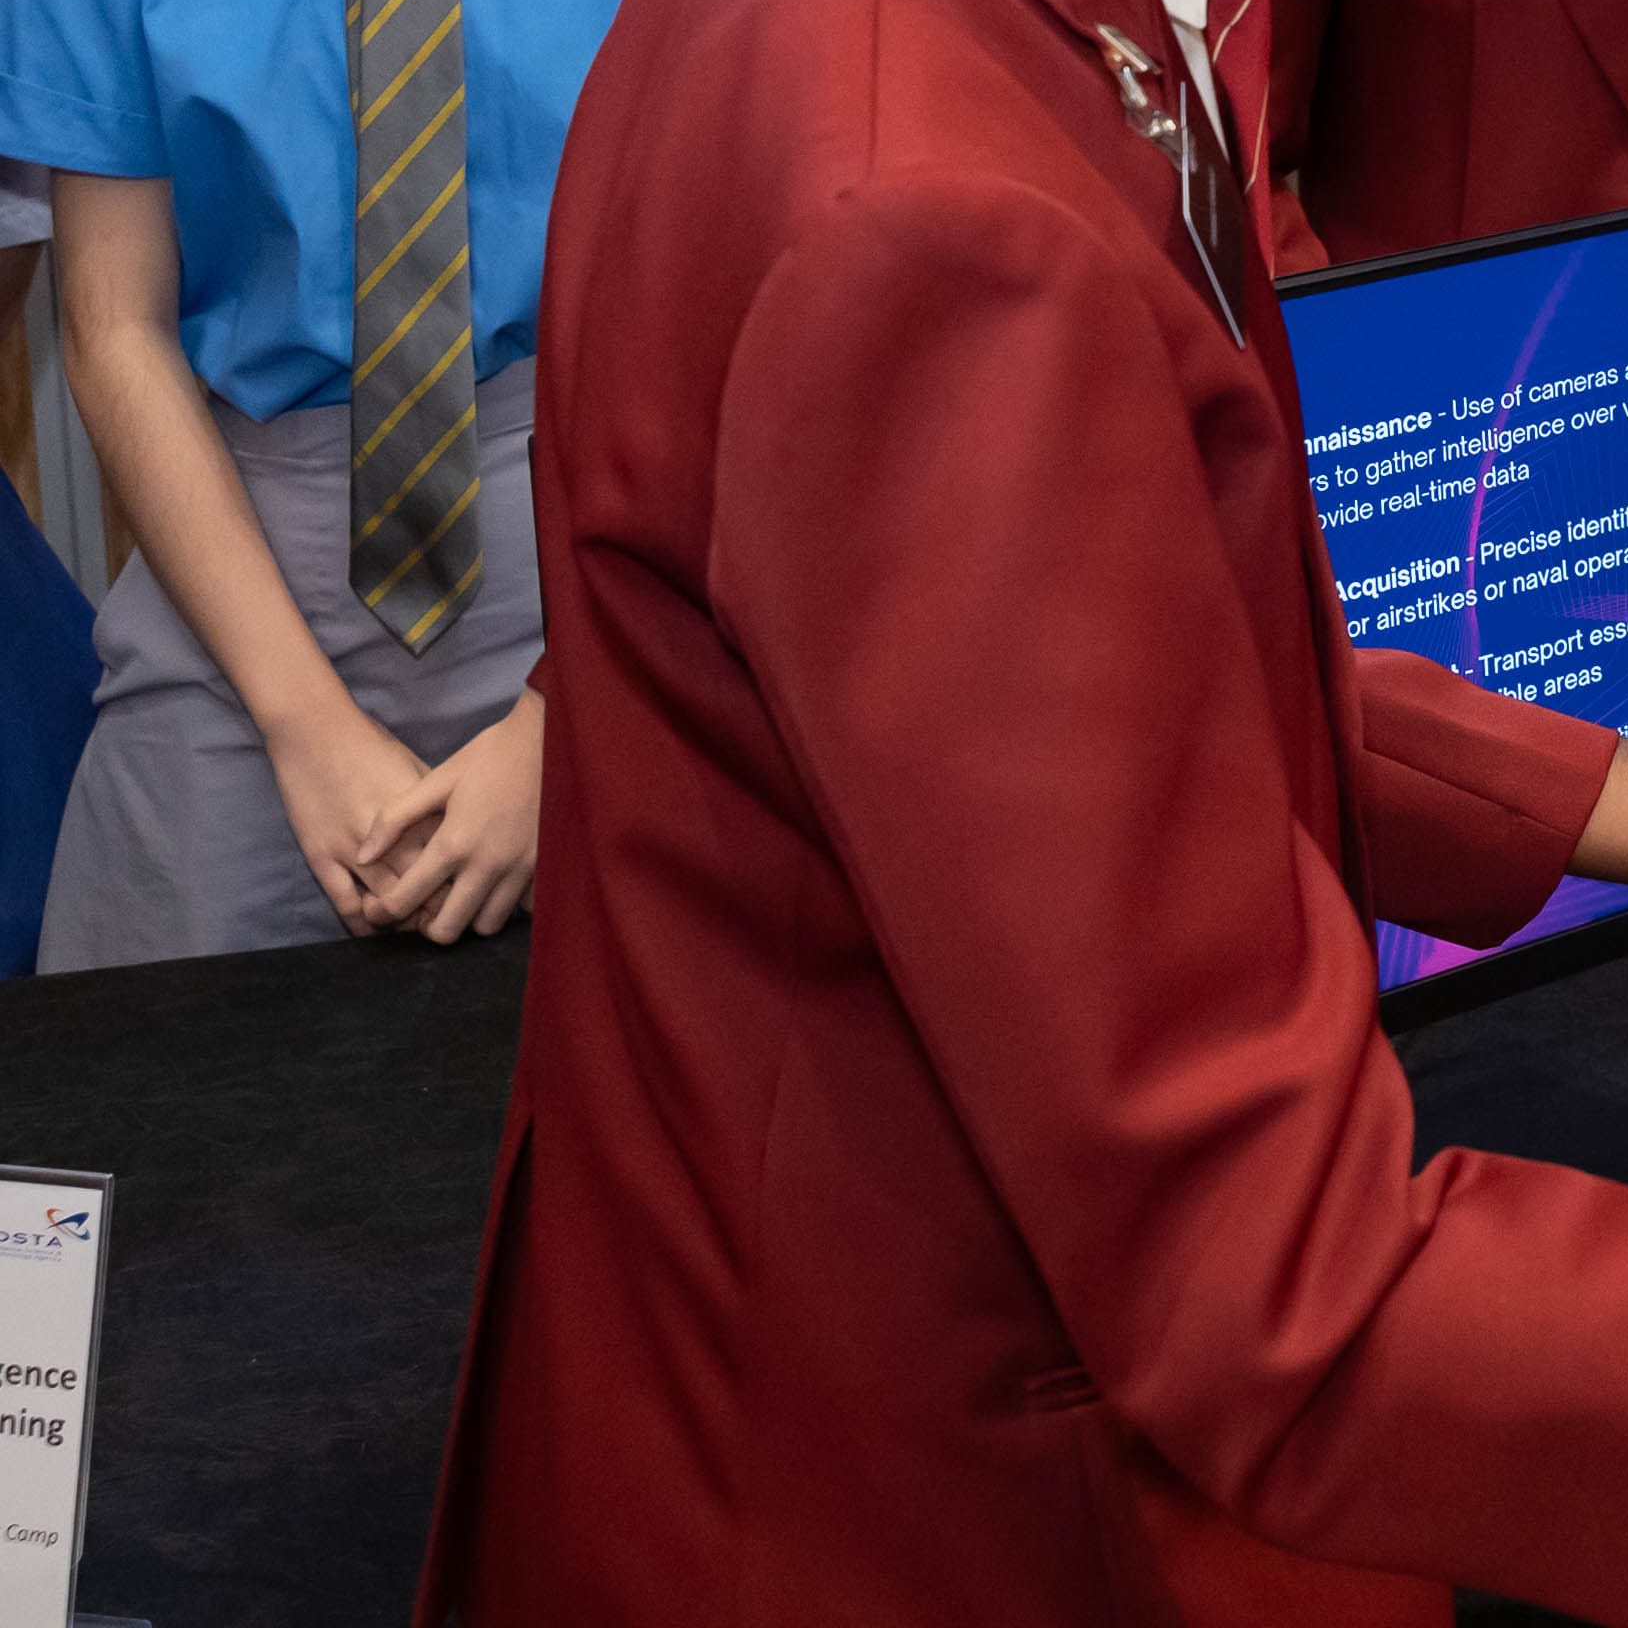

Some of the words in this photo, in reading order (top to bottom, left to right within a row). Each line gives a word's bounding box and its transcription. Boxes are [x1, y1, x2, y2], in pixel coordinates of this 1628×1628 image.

[1452, 397, 1495, 420] Use
[1500, 384, 1523, 409] of
[1528, 368, 1618, 403] cameras
[1335, 465, 1359, 488] to
[1365, 447, 1436, 485] gather
[1442, 417, 1565, 462] intelligence
[1571, 405, 1617, 430] over
[1380, 479, 1477, 515] real-time
[1483, 461, 1530, 489] data
[1480, 530, 1561, 565] Precise
[1347, 616, 1370, 638] or
[1376, 588, 1478, 631] airstrikes
[1484, 580, 1507, 601] or
[1513, 559, 1569, 595] naval
[1478, 629, 1583, 677] Transport
[1543, 664, 1603, 697] areas
[6, 1523, 59, 1548] Camp
